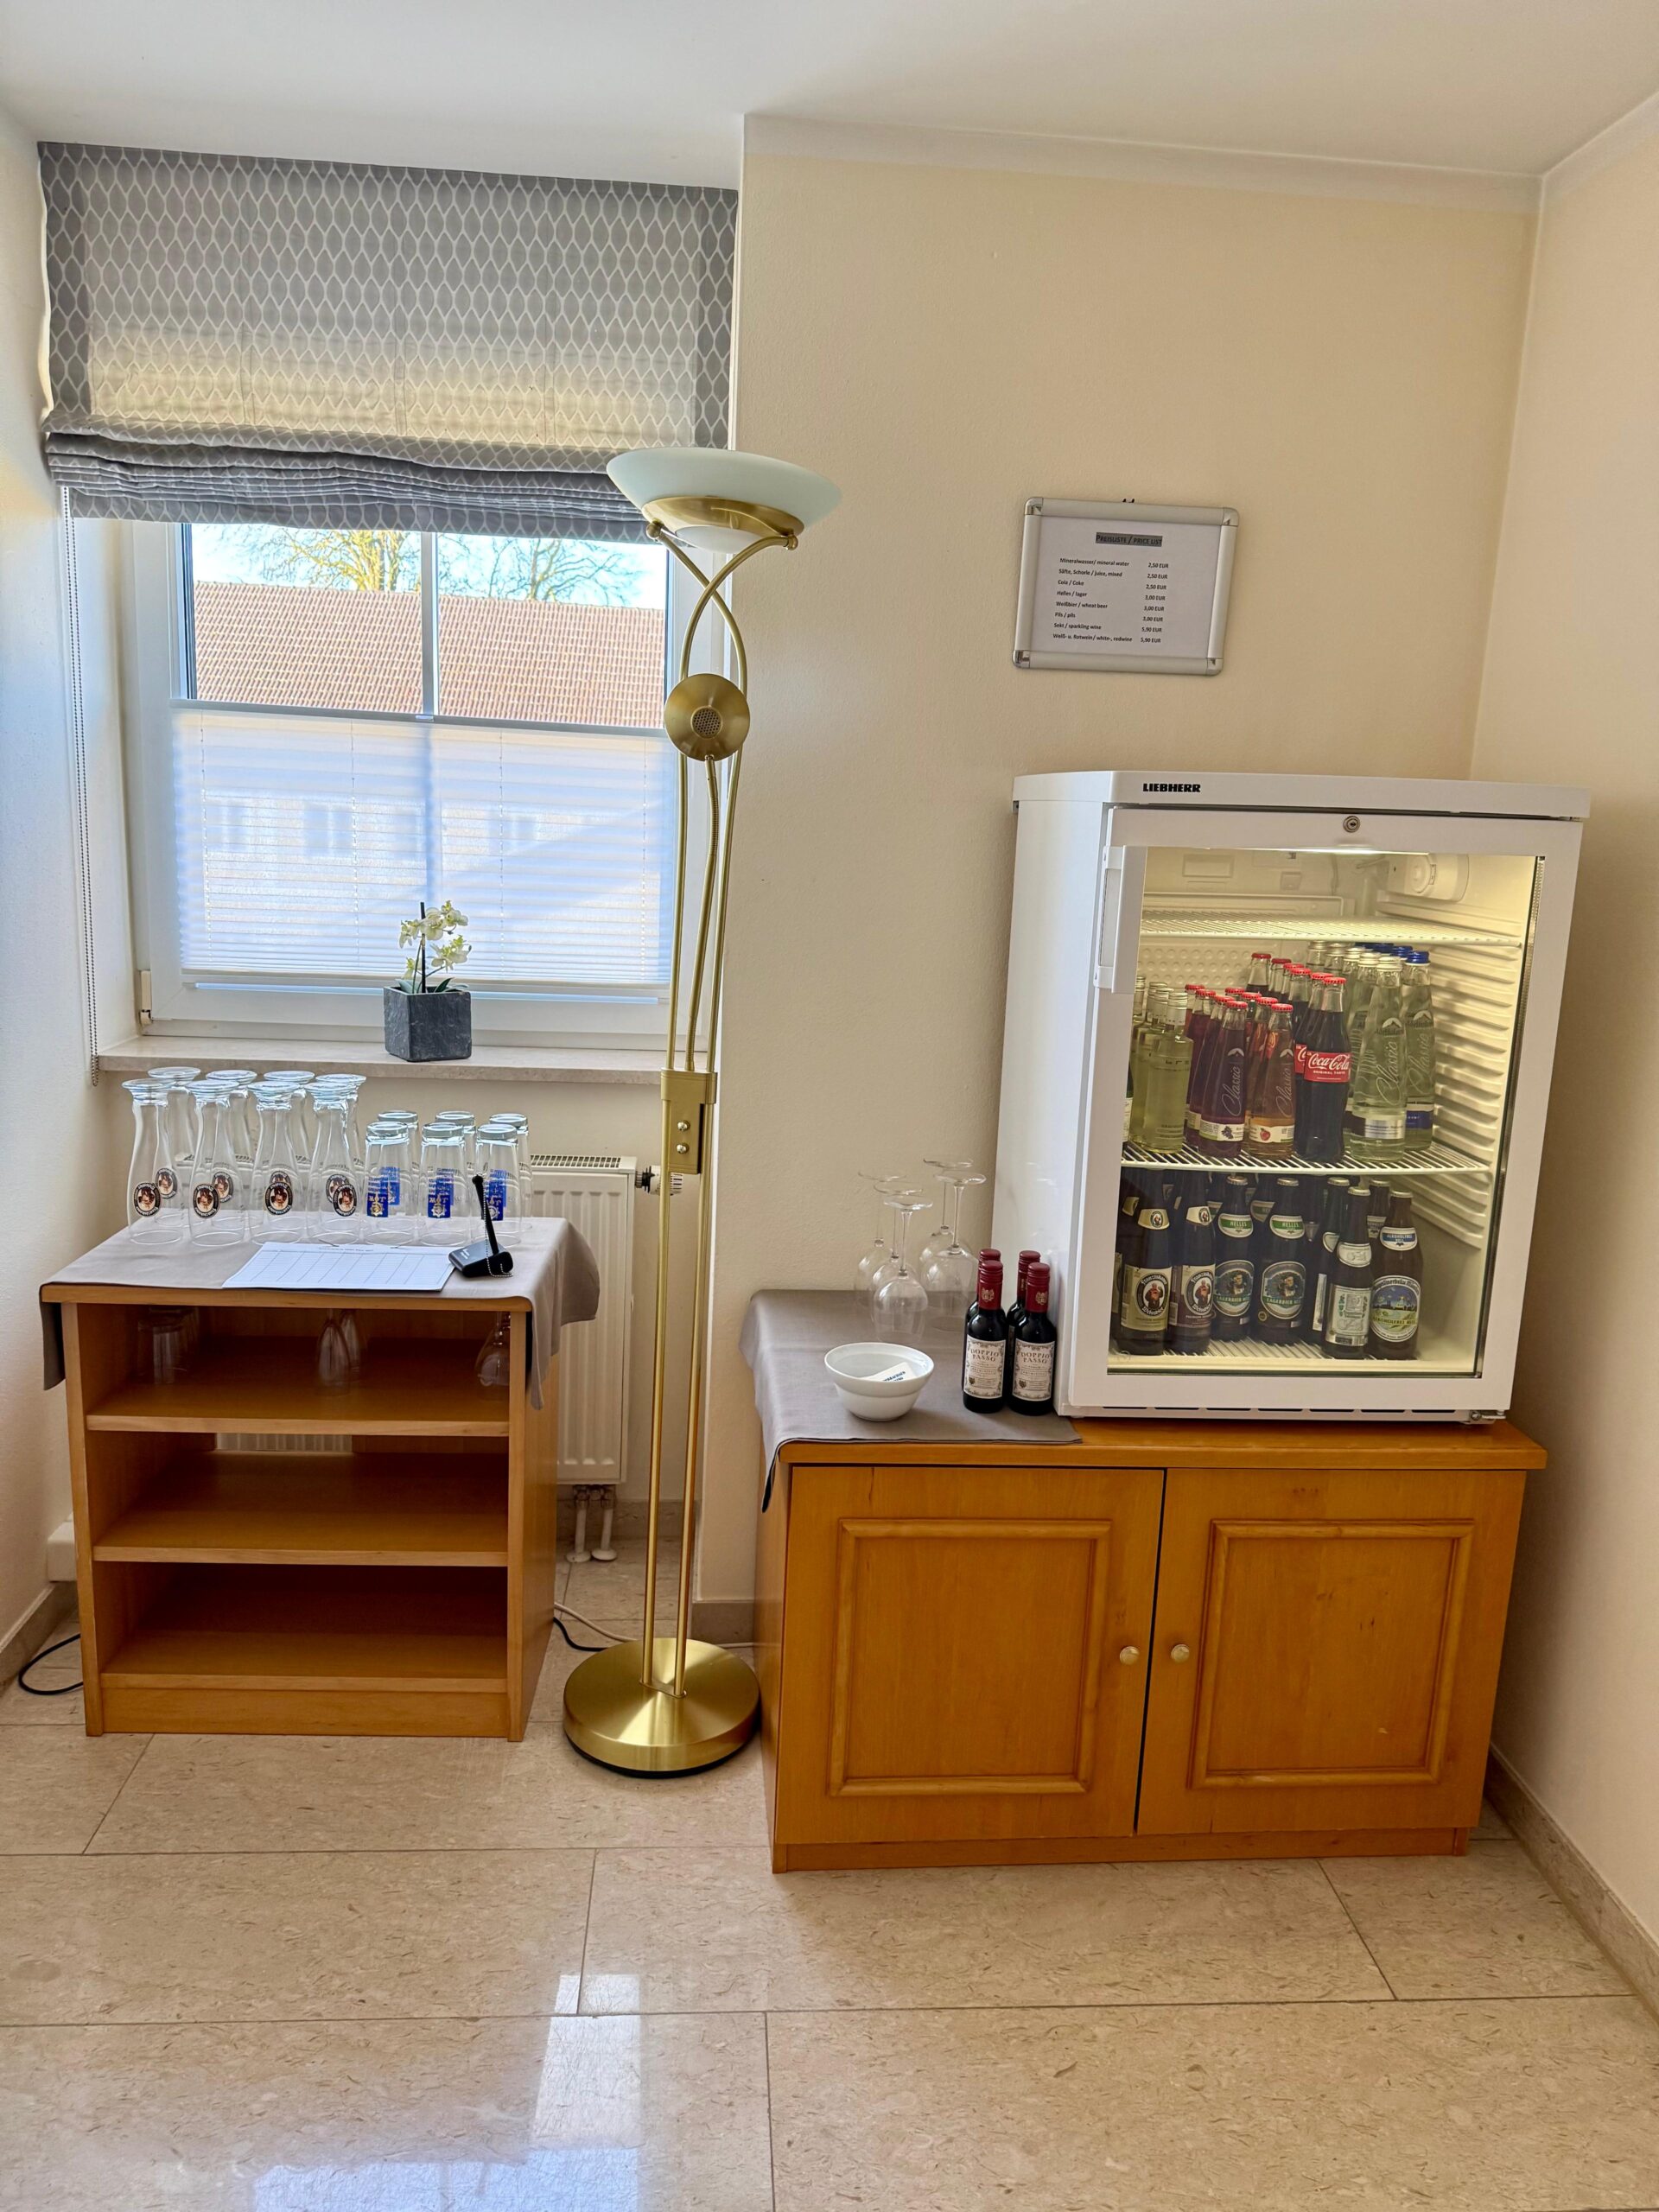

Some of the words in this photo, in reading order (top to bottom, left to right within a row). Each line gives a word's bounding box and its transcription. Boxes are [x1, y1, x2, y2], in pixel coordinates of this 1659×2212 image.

[1142, 783, 1201, 792] LIEBHERR
[1307, 1052, 1351, 1071] Coca-Cola
[1376, 1040, 1402, 1106] Classic
[1221, 1065, 1242, 1116] Classic
[1275, 1068, 1294, 1117] Classic
[970, 1348, 1000, 1357] DOPPIO
[972, 1354, 996, 1363] PASSO
